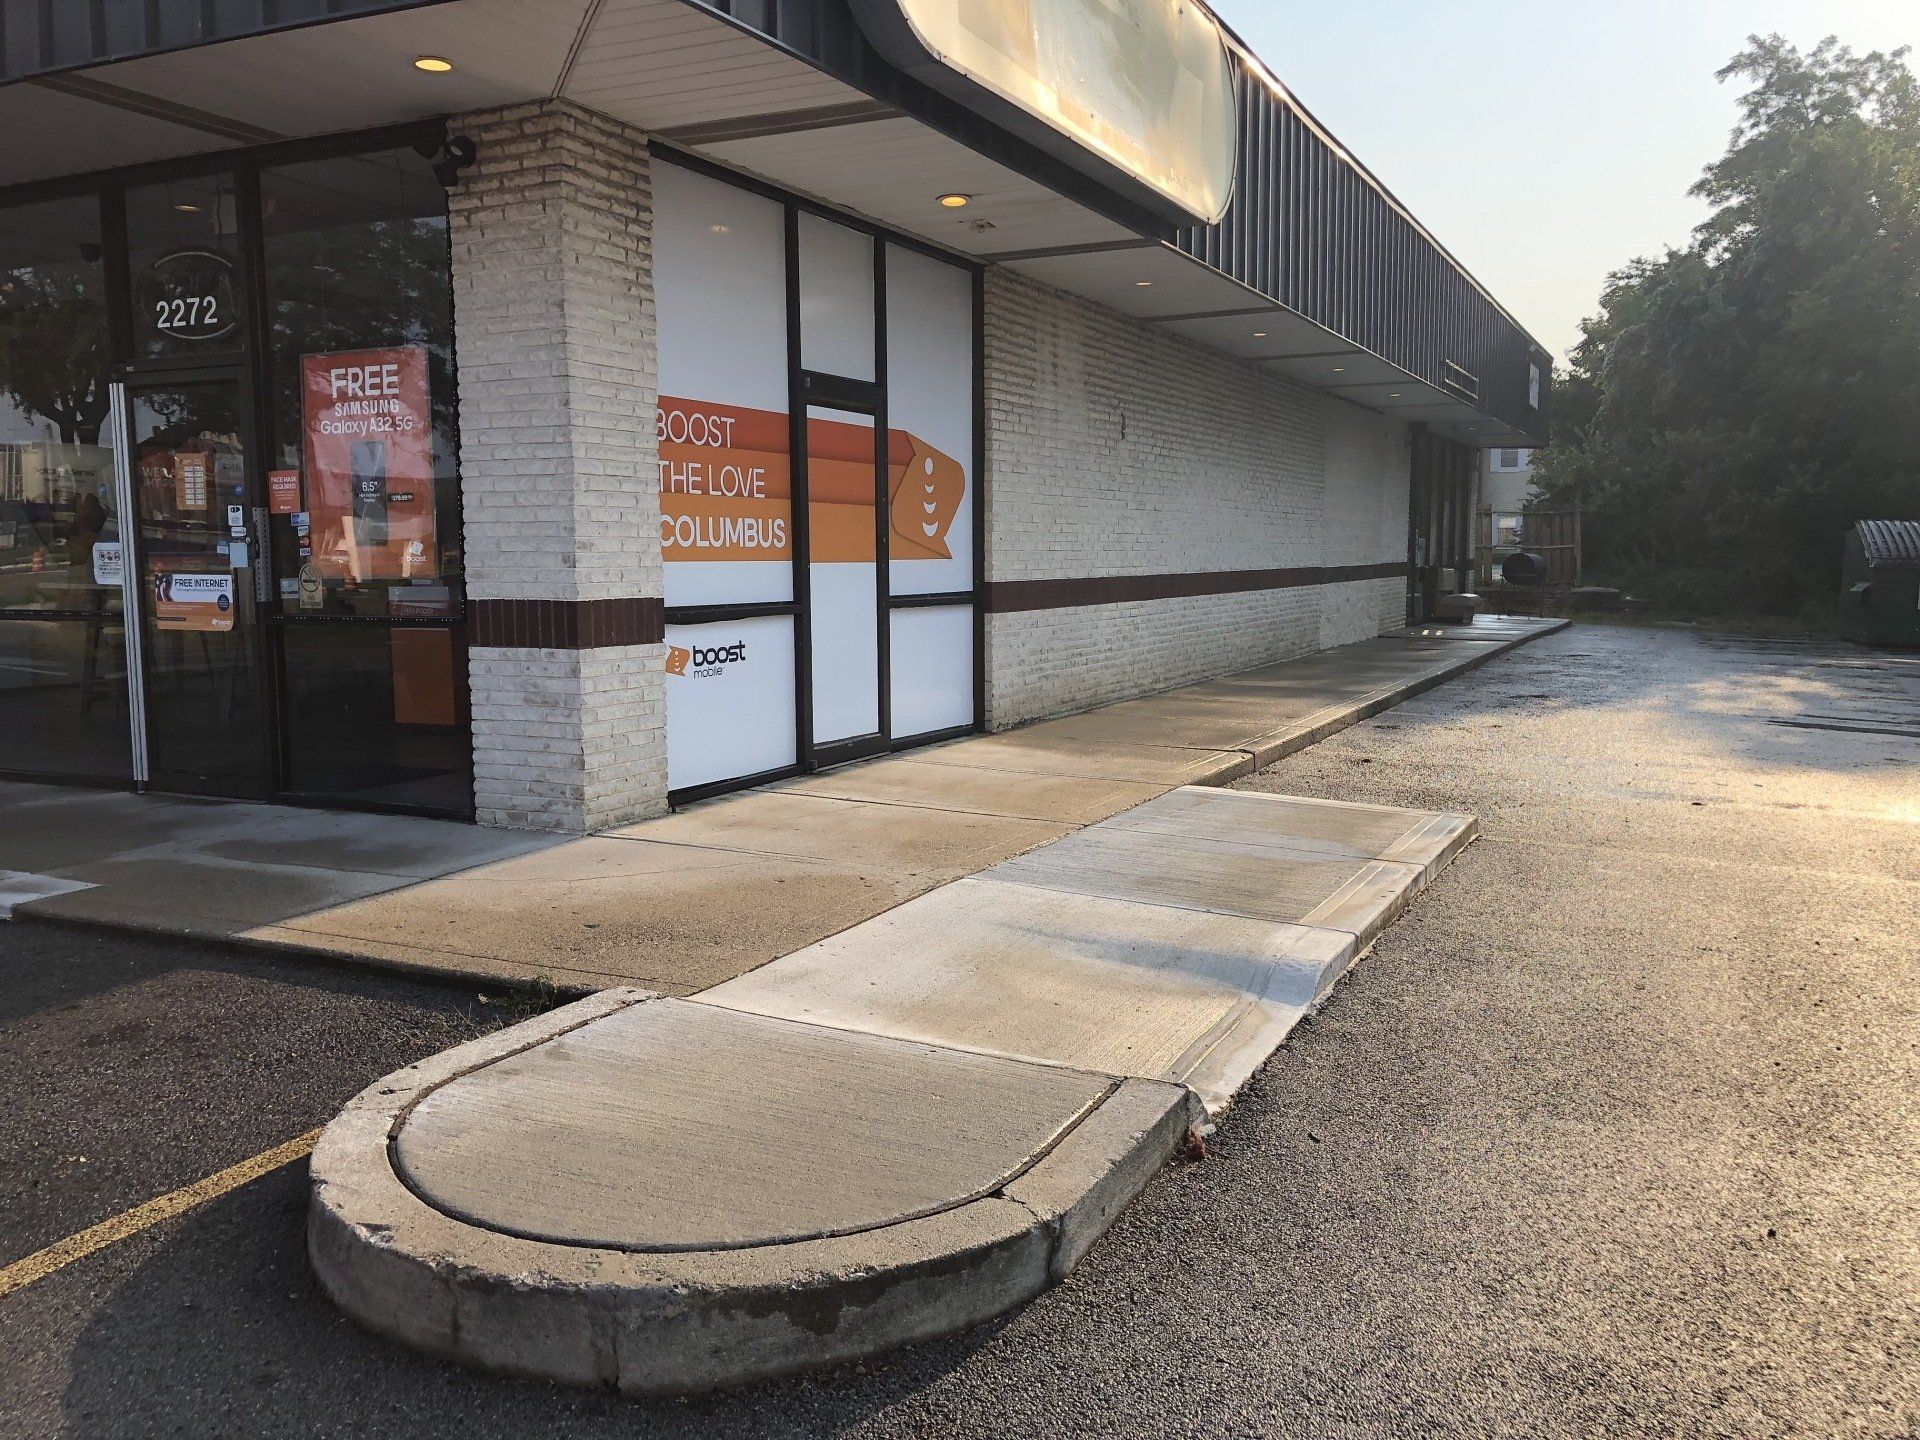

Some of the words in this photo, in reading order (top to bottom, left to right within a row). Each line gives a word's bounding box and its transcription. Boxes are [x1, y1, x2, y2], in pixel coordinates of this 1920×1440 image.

[156, 295, 218, 329] 2272
[330, 363, 400, 399] FREE
[334, 399, 400, 417] SAMSUNG
[320, 420, 368, 438] Galaxy
[369, 416, 394, 434] A32
[395, 415, 413, 431] 5G
[657, 408, 736, 449] BOOST
[658, 460, 702, 495] THE
[708, 464, 766, 498] LOVE
[660, 514, 786, 549] COLUMBUS
[174, 578, 193, 588] FREE
[193, 579, 229, 588] INTERNET
[692, 640, 746, 667] boost
[693, 666, 723, 679] mobile
